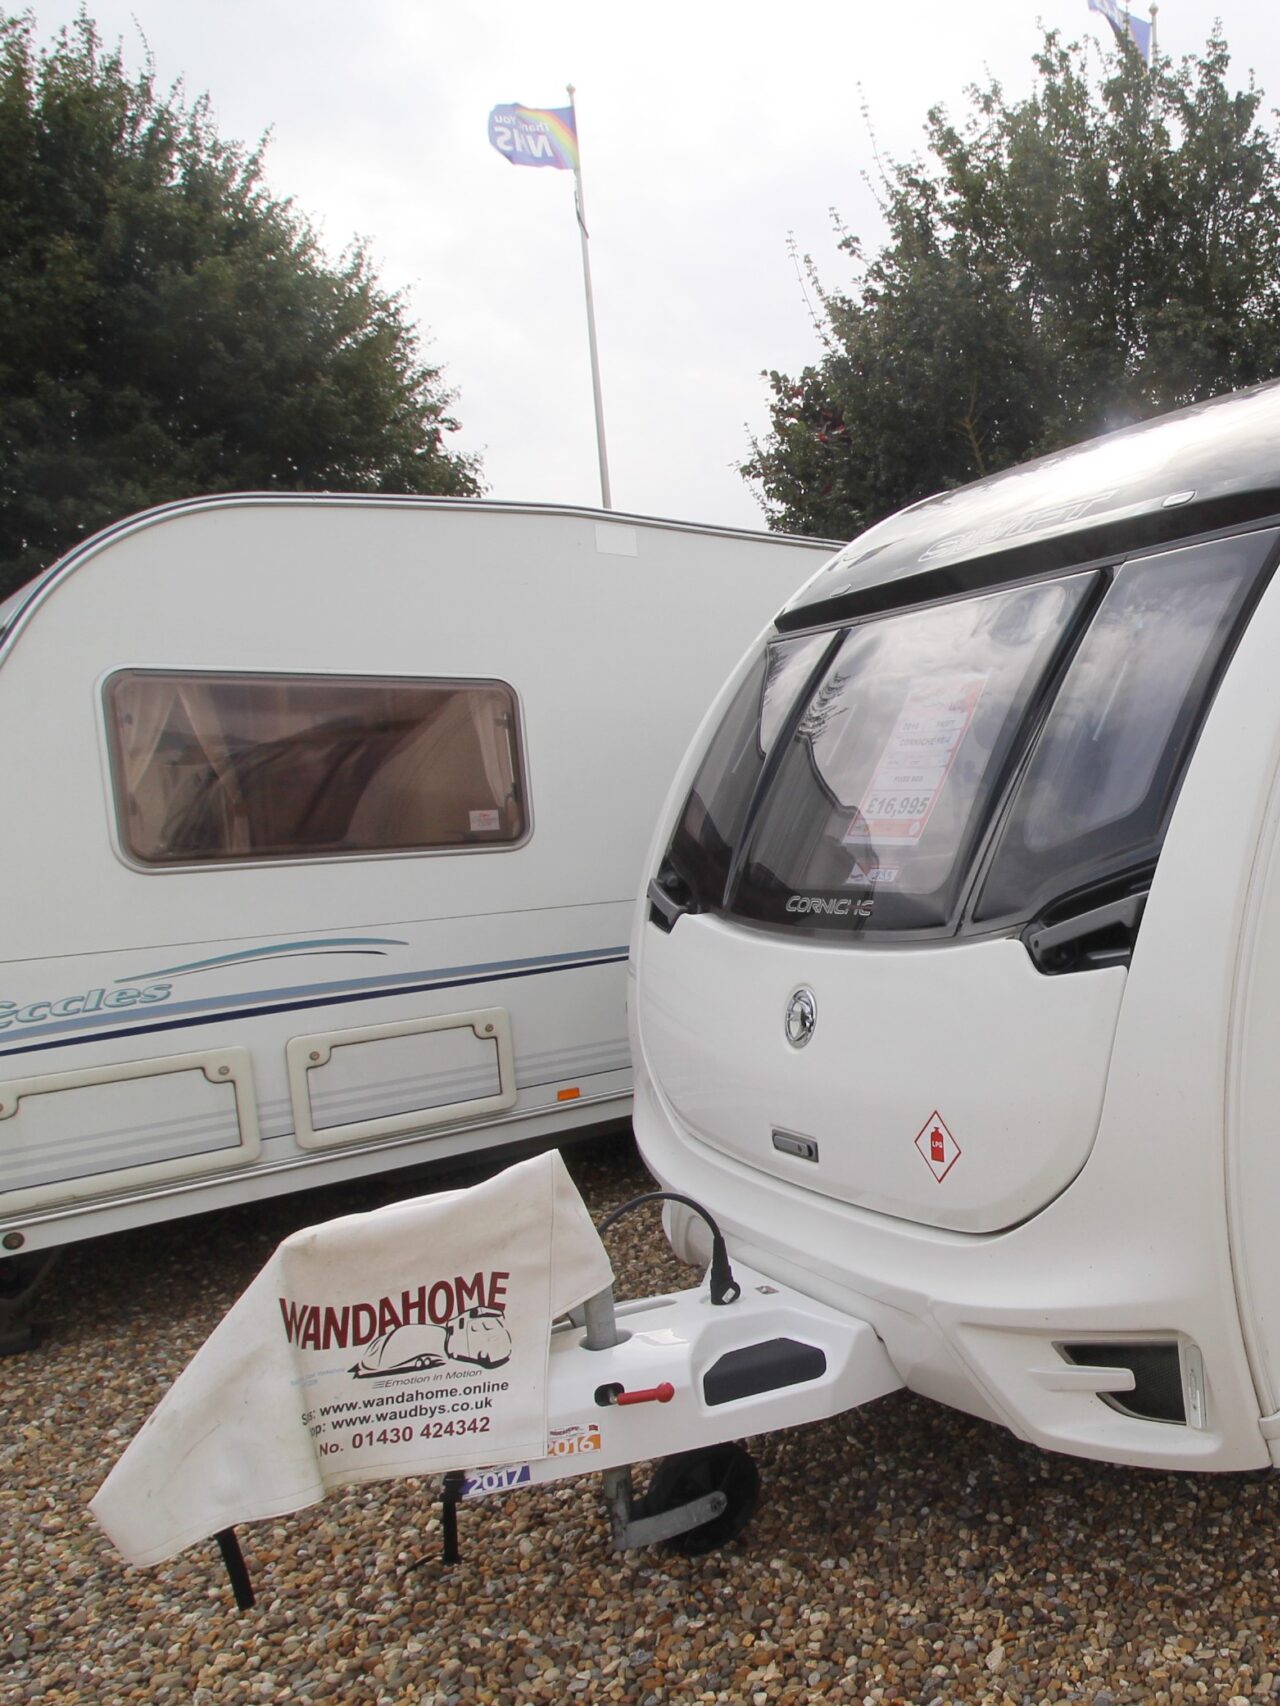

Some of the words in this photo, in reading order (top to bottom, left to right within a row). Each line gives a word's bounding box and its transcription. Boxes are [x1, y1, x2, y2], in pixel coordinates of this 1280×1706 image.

[865, 797, 931, 818] £16,995
[785, 894, 875, 916] CORNICHE
[931, 1141, 944, 1149] LPG
[279, 1271, 510, 1350] WANDAHOME
[384, 1376, 431, 1389] Emotion
[432, 1372, 443, 1382] in
[445, 1369, 483, 1380] Motion
[319, 1381, 509, 1416] www.wandahome.online
[331, 1396, 493, 1431] www.waudbys.co.uk
[351, 1425, 414, 1449] 01430
[419, 1416, 491, 1440] 424342
[467, 1466, 523, 1496] 2017
